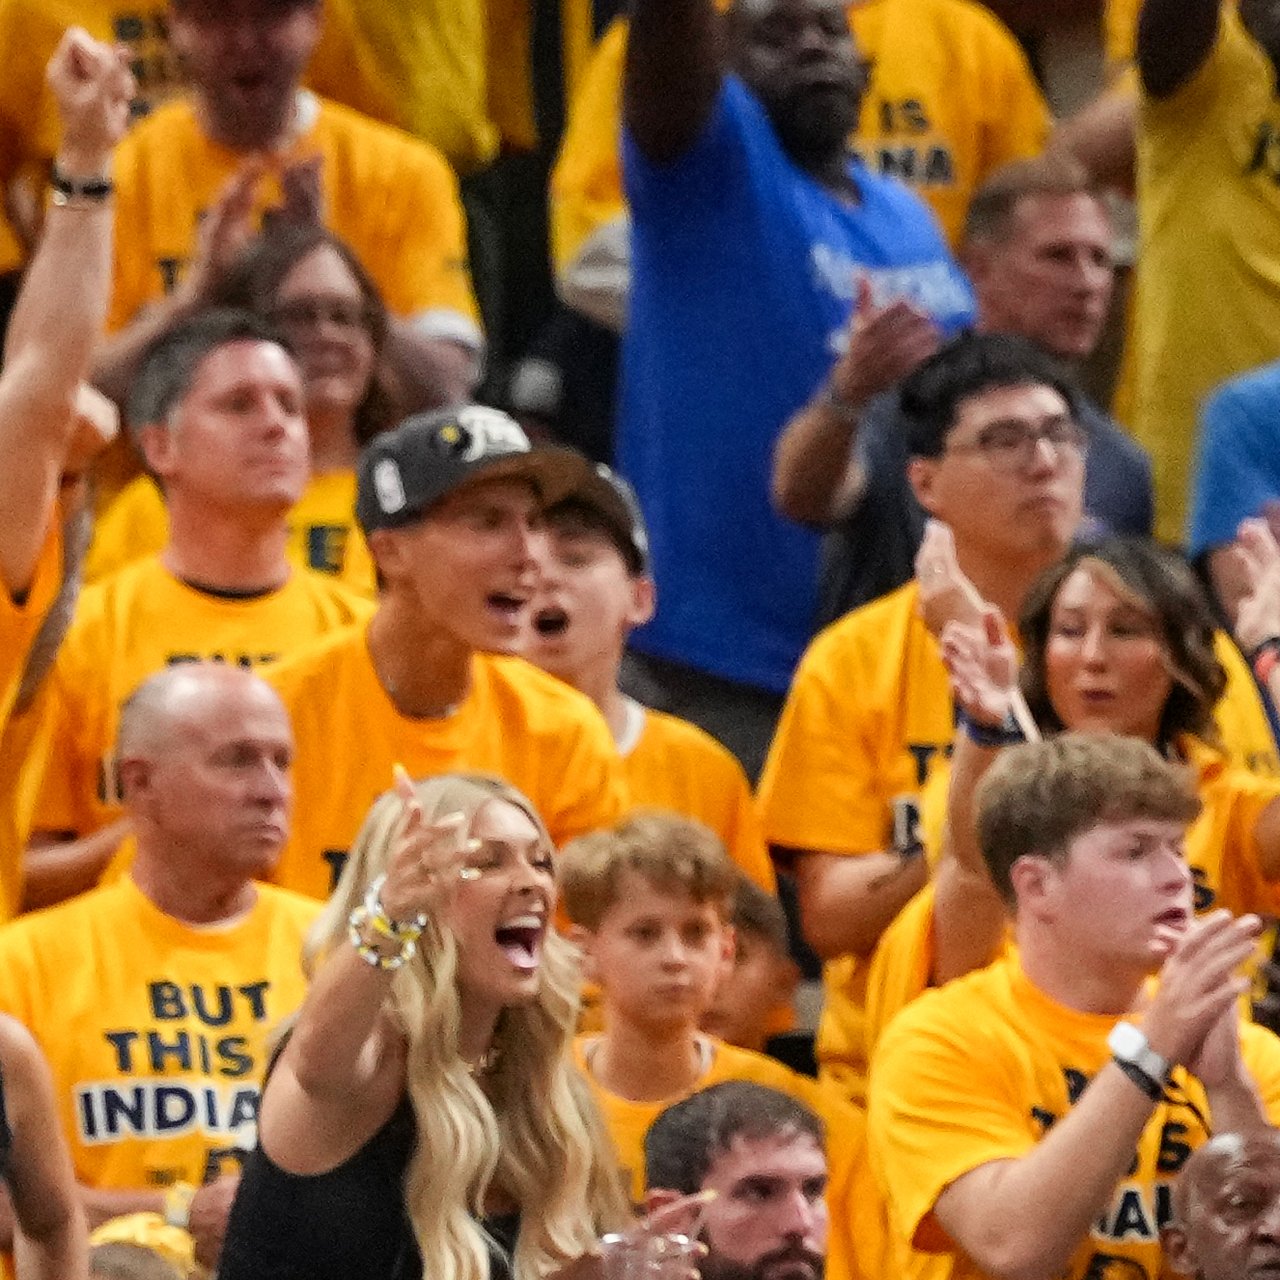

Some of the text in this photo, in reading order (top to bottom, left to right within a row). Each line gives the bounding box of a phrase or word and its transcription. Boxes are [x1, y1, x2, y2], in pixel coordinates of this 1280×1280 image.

[147, 978, 271, 1027] BUT
[103, 1030, 255, 1077] THIS
[79, 1085, 260, 1138] INDIA
